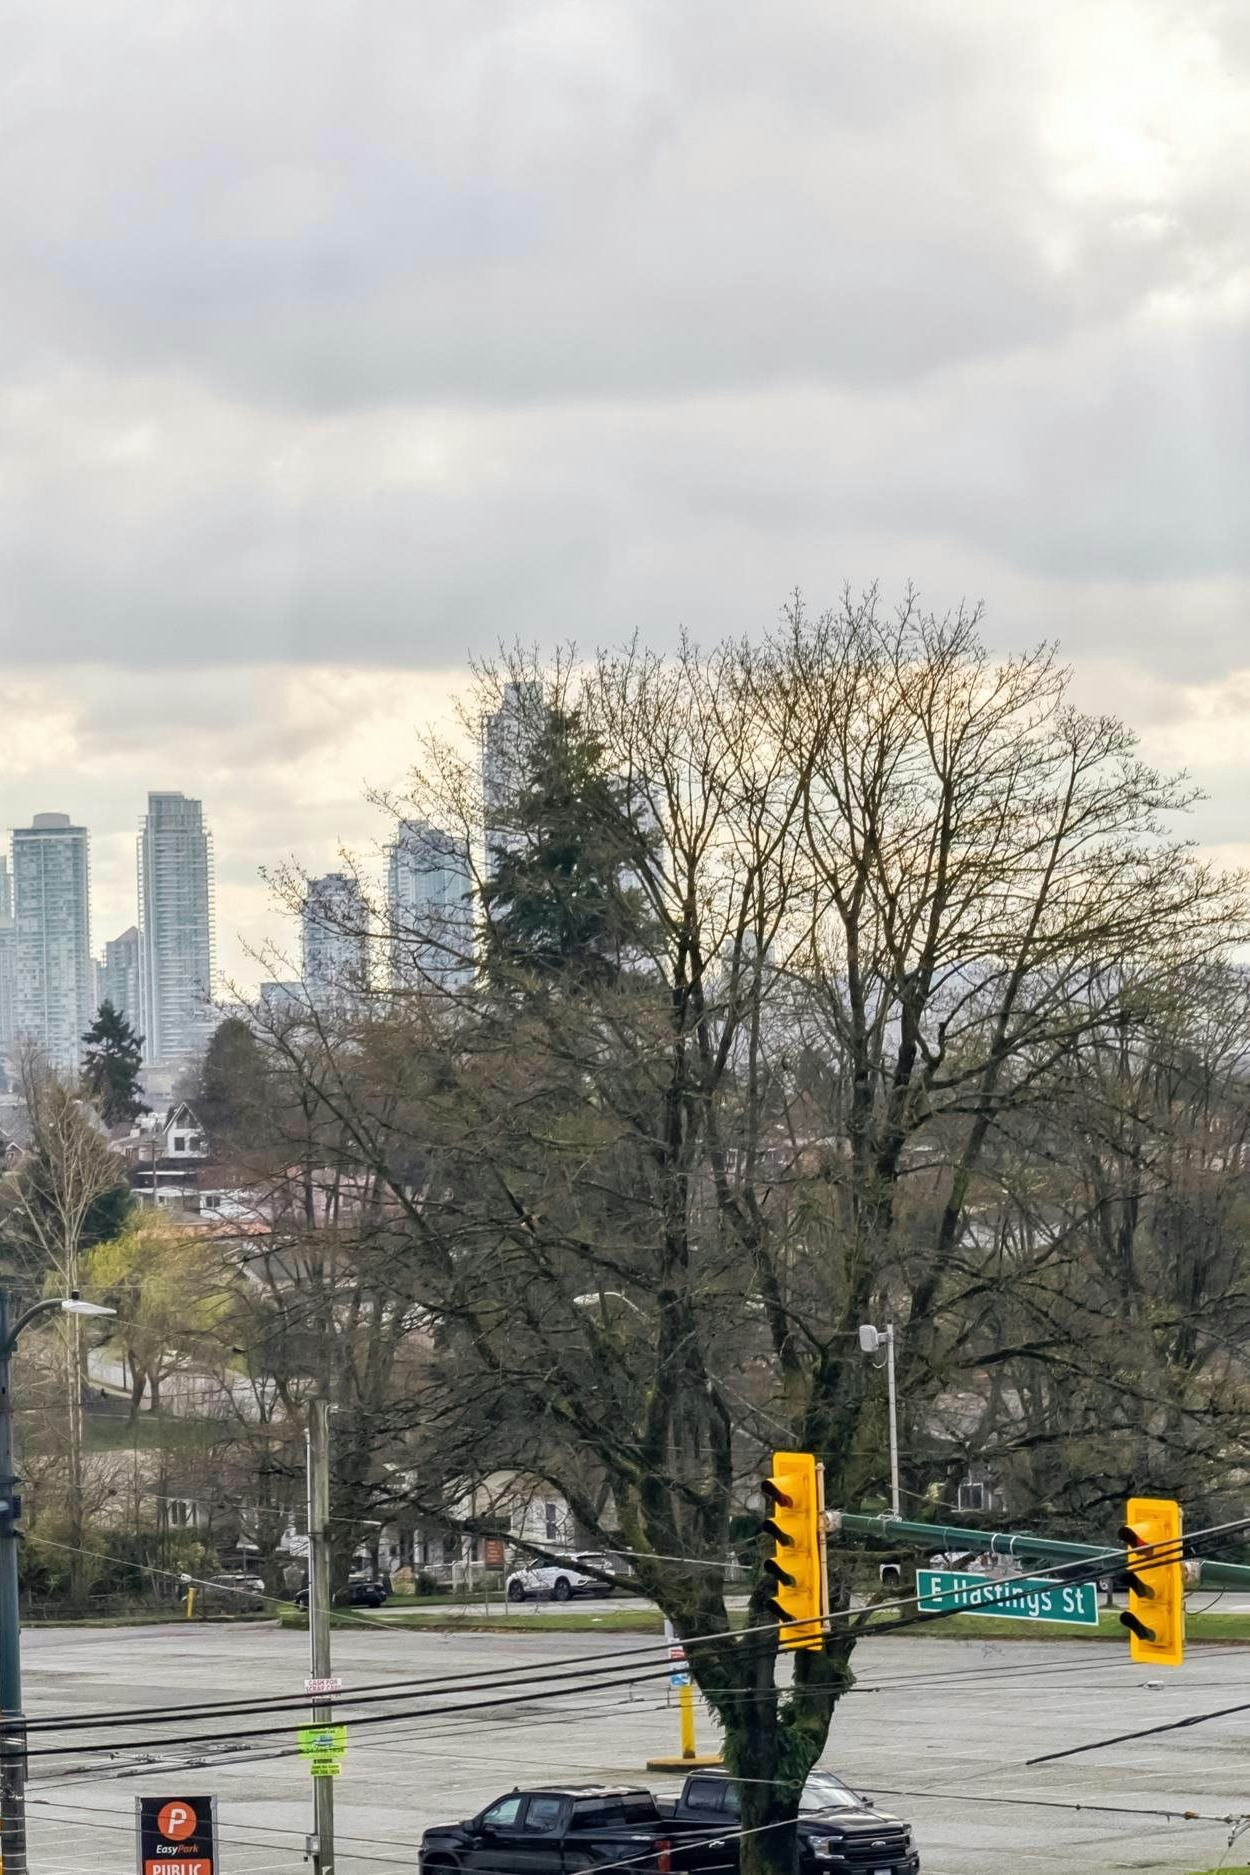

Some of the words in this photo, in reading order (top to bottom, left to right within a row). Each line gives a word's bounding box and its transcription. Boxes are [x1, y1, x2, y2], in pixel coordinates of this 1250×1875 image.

[931, 1577, 943, 1602] E
[954, 1579, 1052, 1617] Hastings
[1063, 1588, 1085, 1614] St
[168, 1808, 187, 1834] P
[156, 1844, 199, 1856] EasyPark
[152, 1863, 202, 1875] PUBLIC
